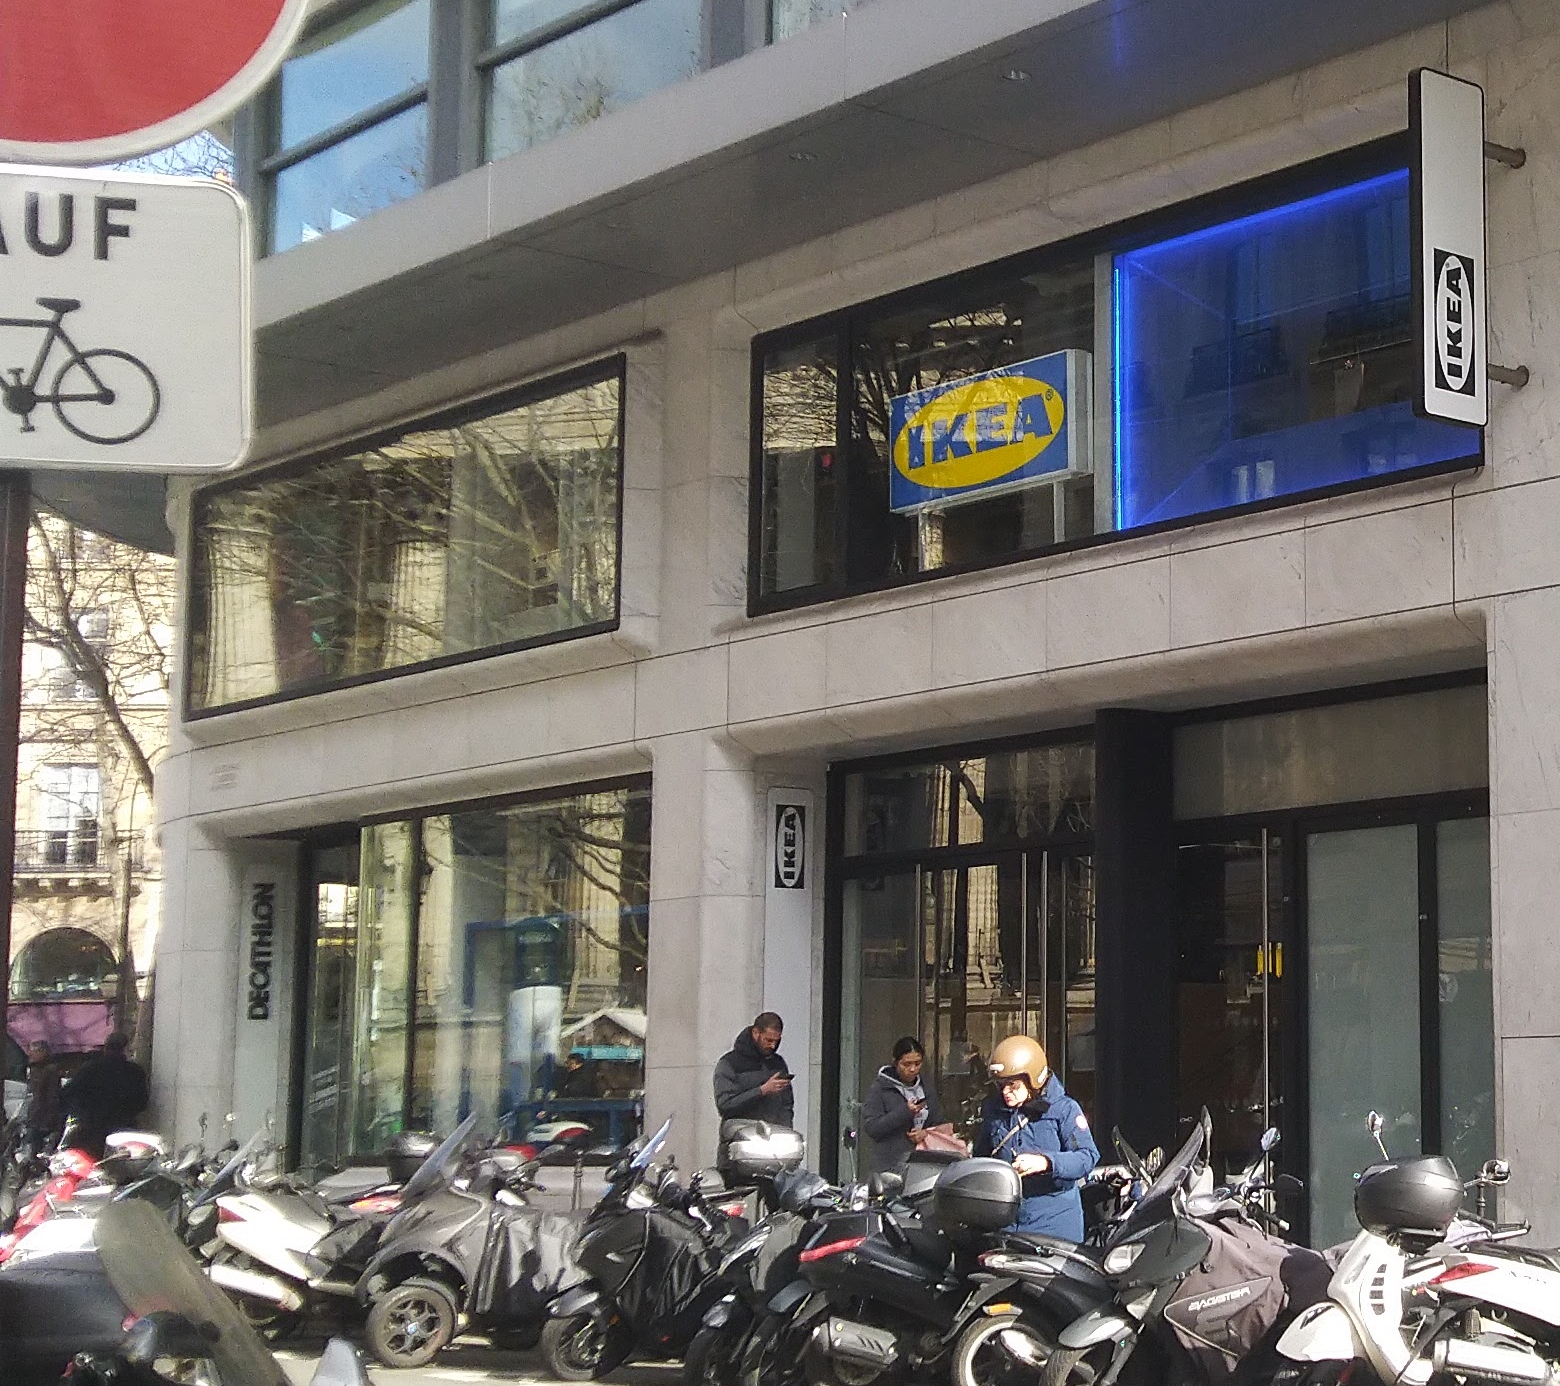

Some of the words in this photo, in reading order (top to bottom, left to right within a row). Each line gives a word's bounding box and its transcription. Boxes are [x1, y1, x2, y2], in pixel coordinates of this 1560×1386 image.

[0, 191, 137, 260] UF
[1446, 266, 1463, 379] IKEA
[907, 393, 1054, 471] IKEA
[784, 813, 797, 880] IKEA
[247, 883, 276, 1020] DECATHLON
